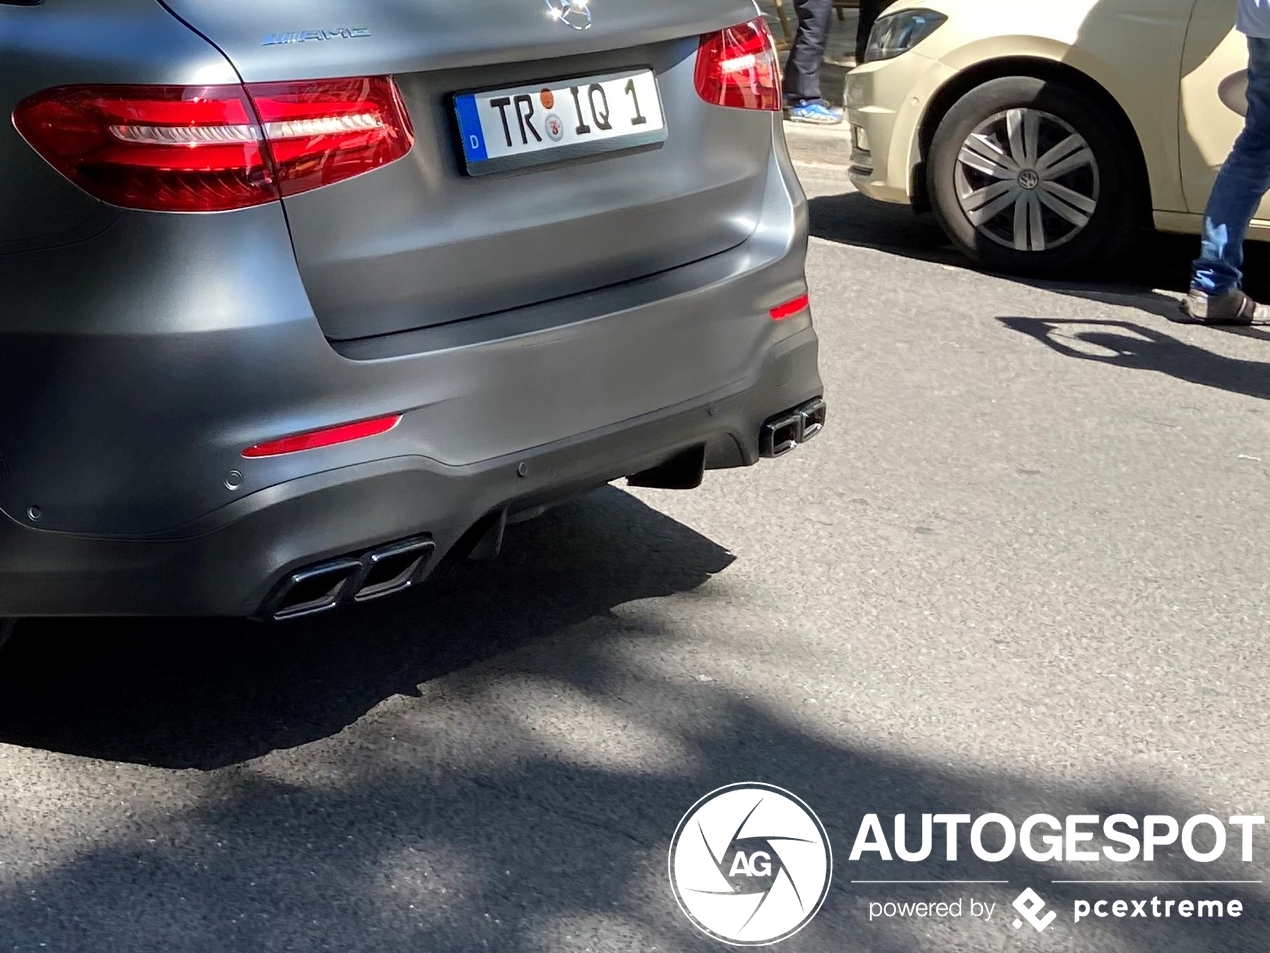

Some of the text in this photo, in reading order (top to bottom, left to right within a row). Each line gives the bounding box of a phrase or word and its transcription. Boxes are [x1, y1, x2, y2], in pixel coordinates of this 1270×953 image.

[490, 78, 647, 147] TR IQ 1
[469, 134, 479, 150] D
